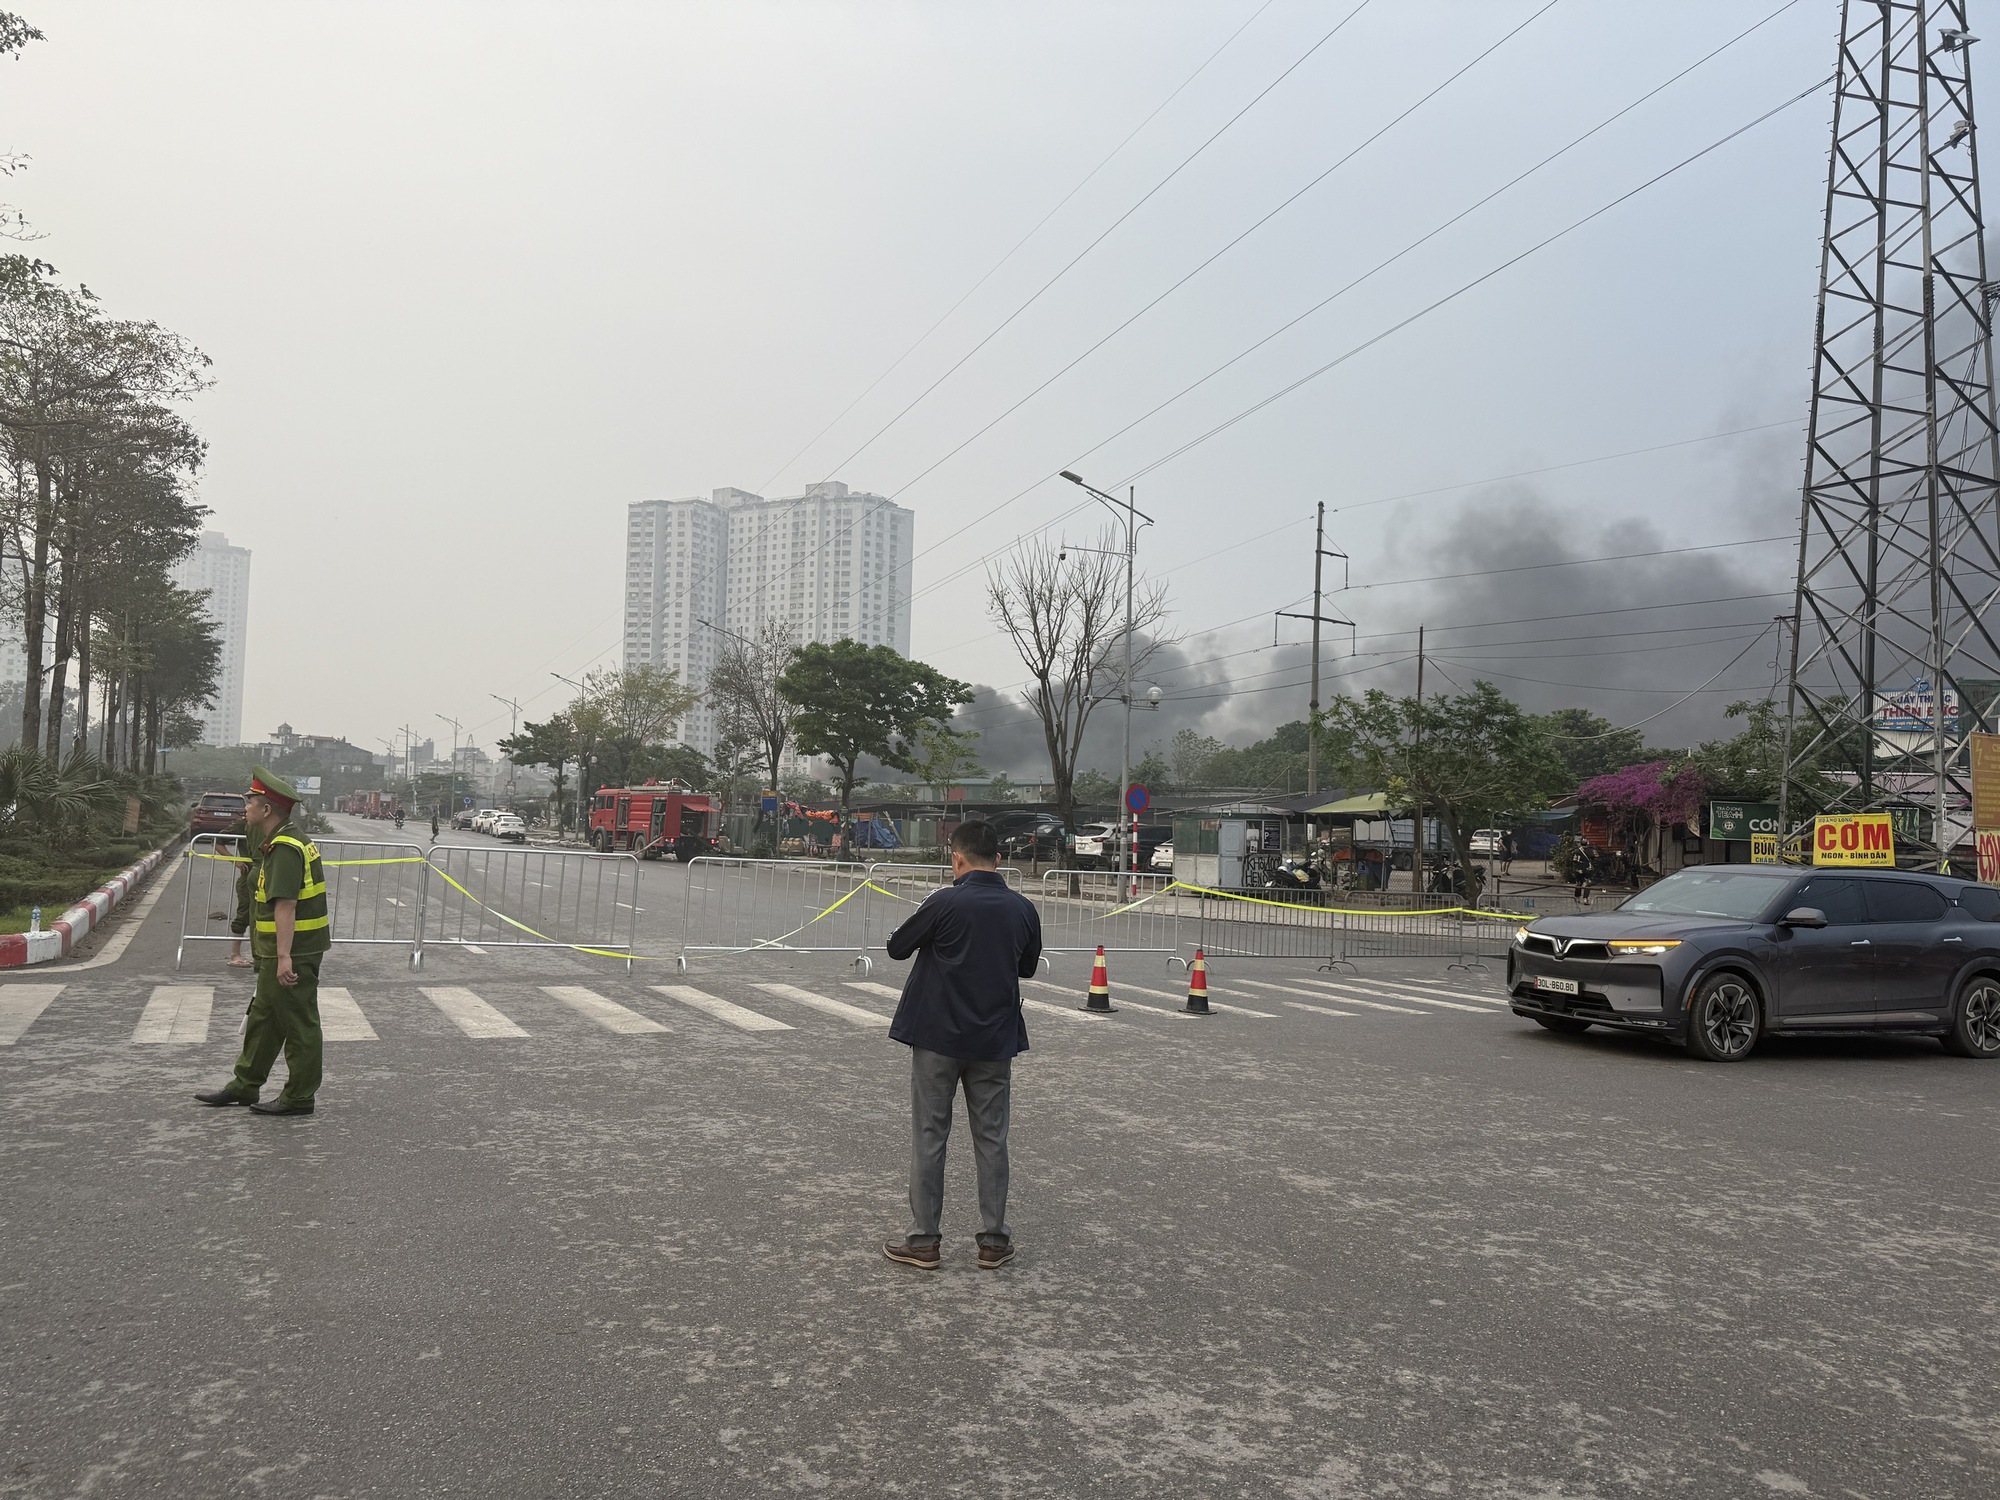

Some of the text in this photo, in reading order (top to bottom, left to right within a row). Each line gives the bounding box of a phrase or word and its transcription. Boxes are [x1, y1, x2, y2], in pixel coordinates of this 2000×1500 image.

[1817, 821, 1891, 851] CƠM
[1753, 840, 1775, 856] BÚN
[1850, 851, 1869, 859] BÌNH
[1870, 851, 1887, 859] DÂN
[1538, 978, 1575, 992] 30L-860.80
